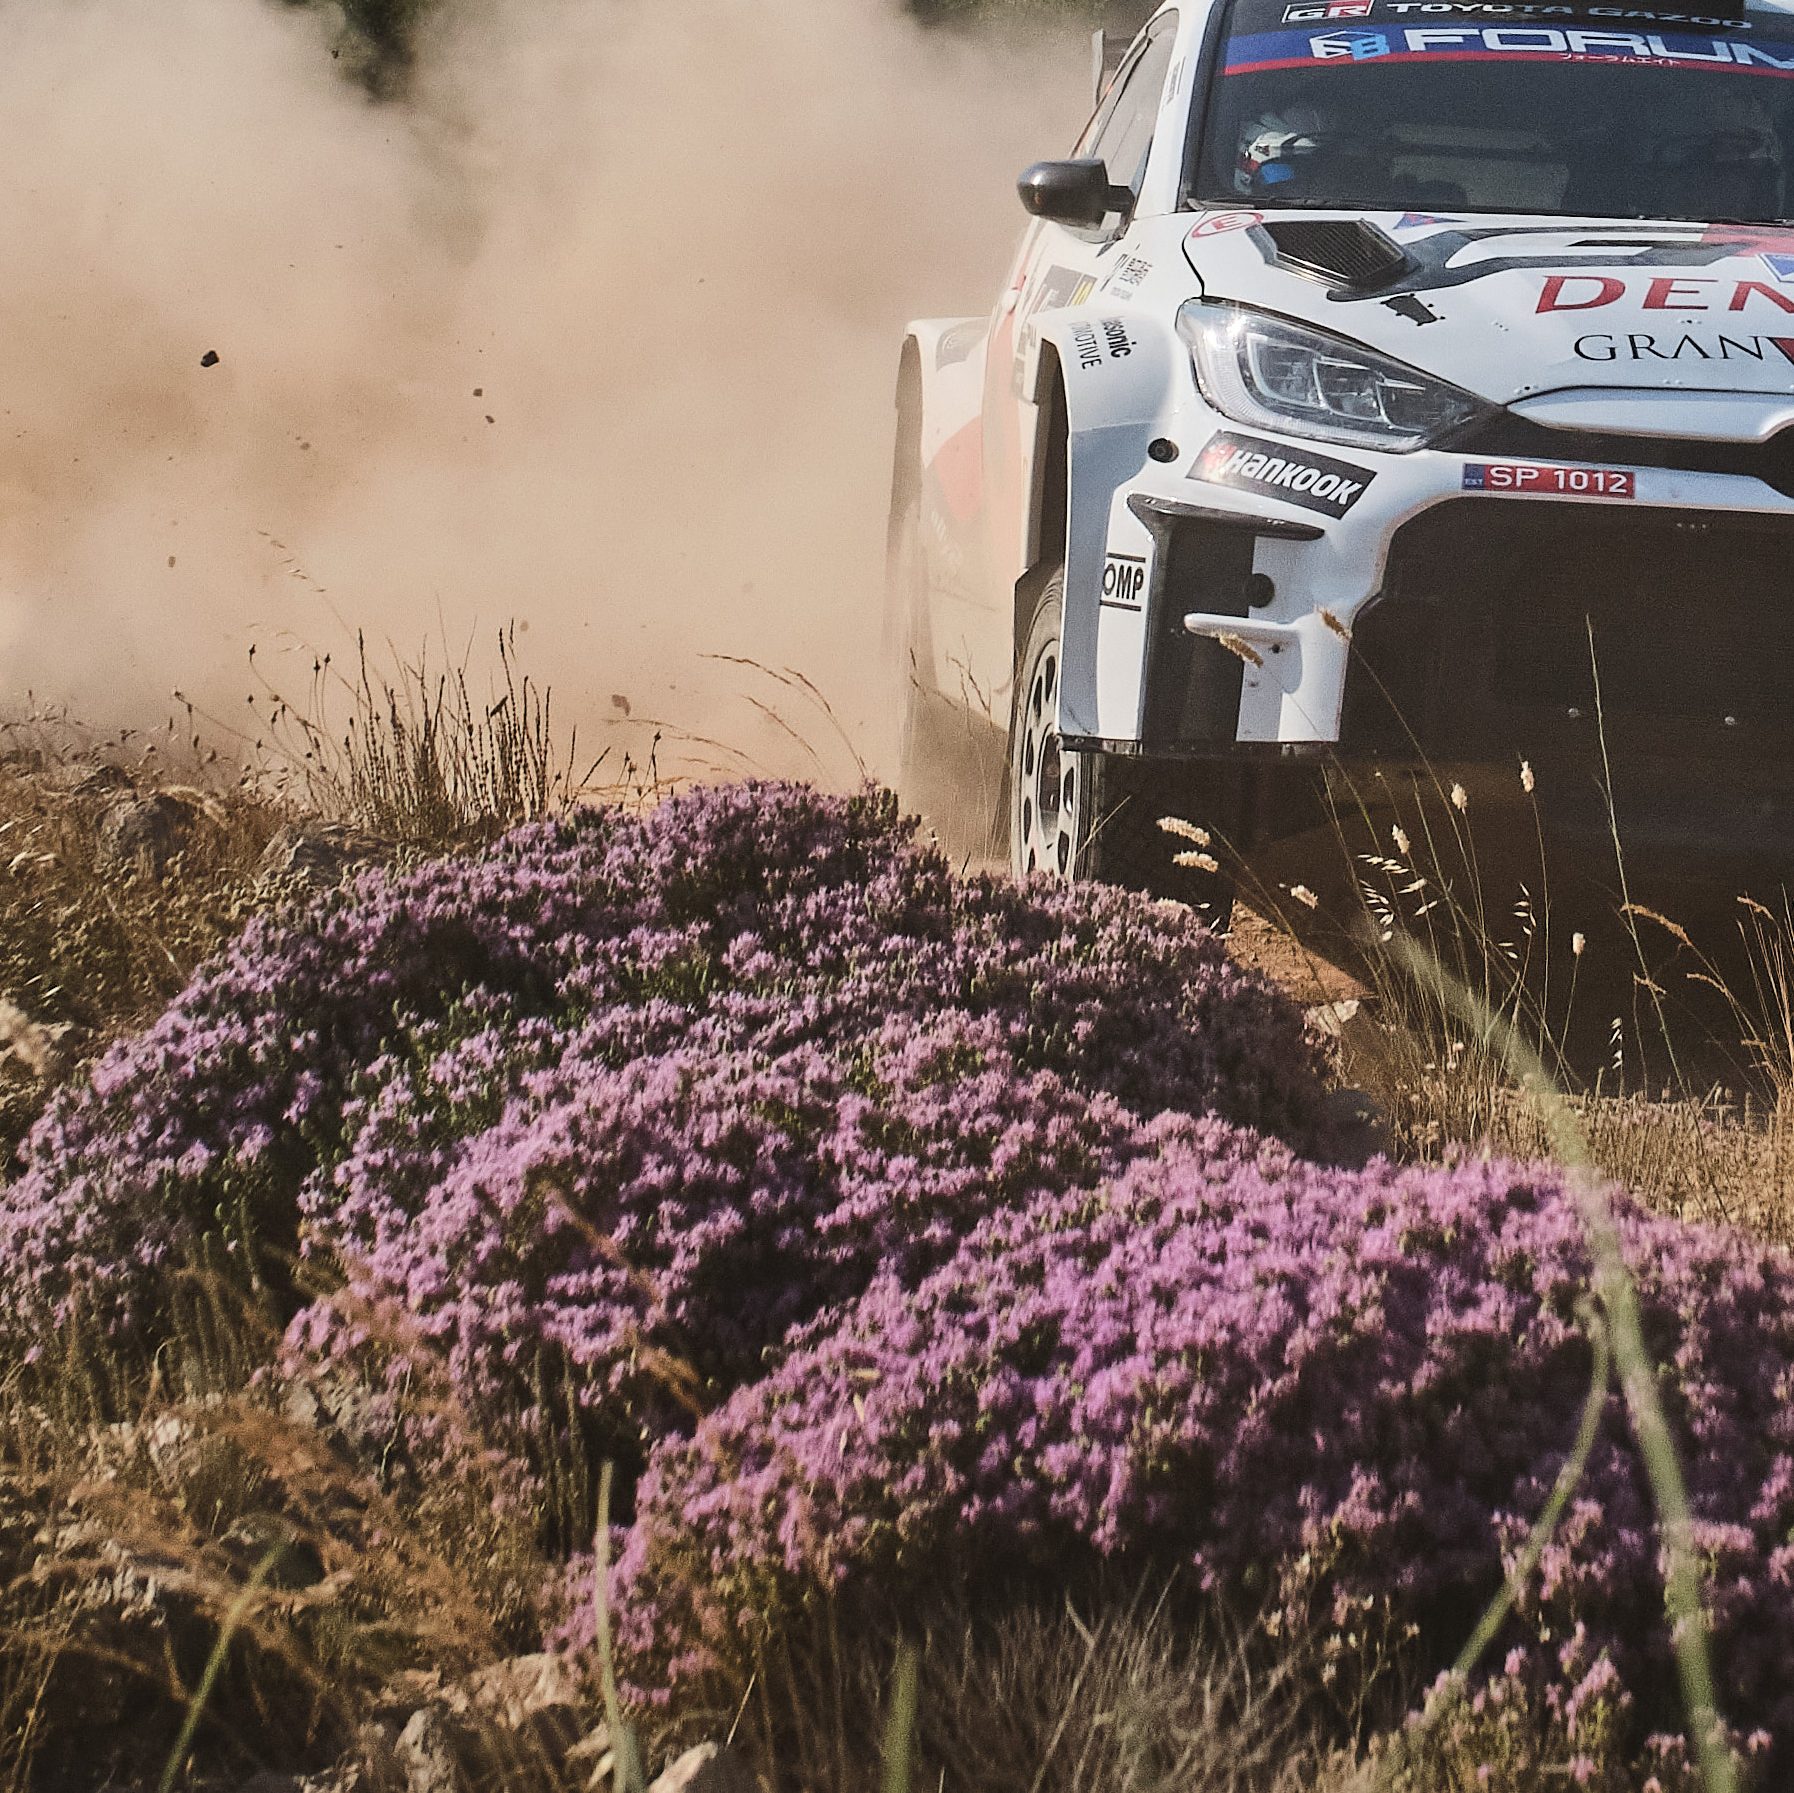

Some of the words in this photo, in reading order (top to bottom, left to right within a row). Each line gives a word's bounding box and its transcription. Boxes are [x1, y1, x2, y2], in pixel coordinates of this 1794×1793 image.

[1284, 3, 1370, 21] GR
[1386, 2, 1573, 14] TOYOTA
[1587, 7, 1752, 29] GAZOO
[1489, 466, 1539, 488] SP
[1553, 469, 1628, 494] 1012
[1101, 562, 1145, 601] OMP
